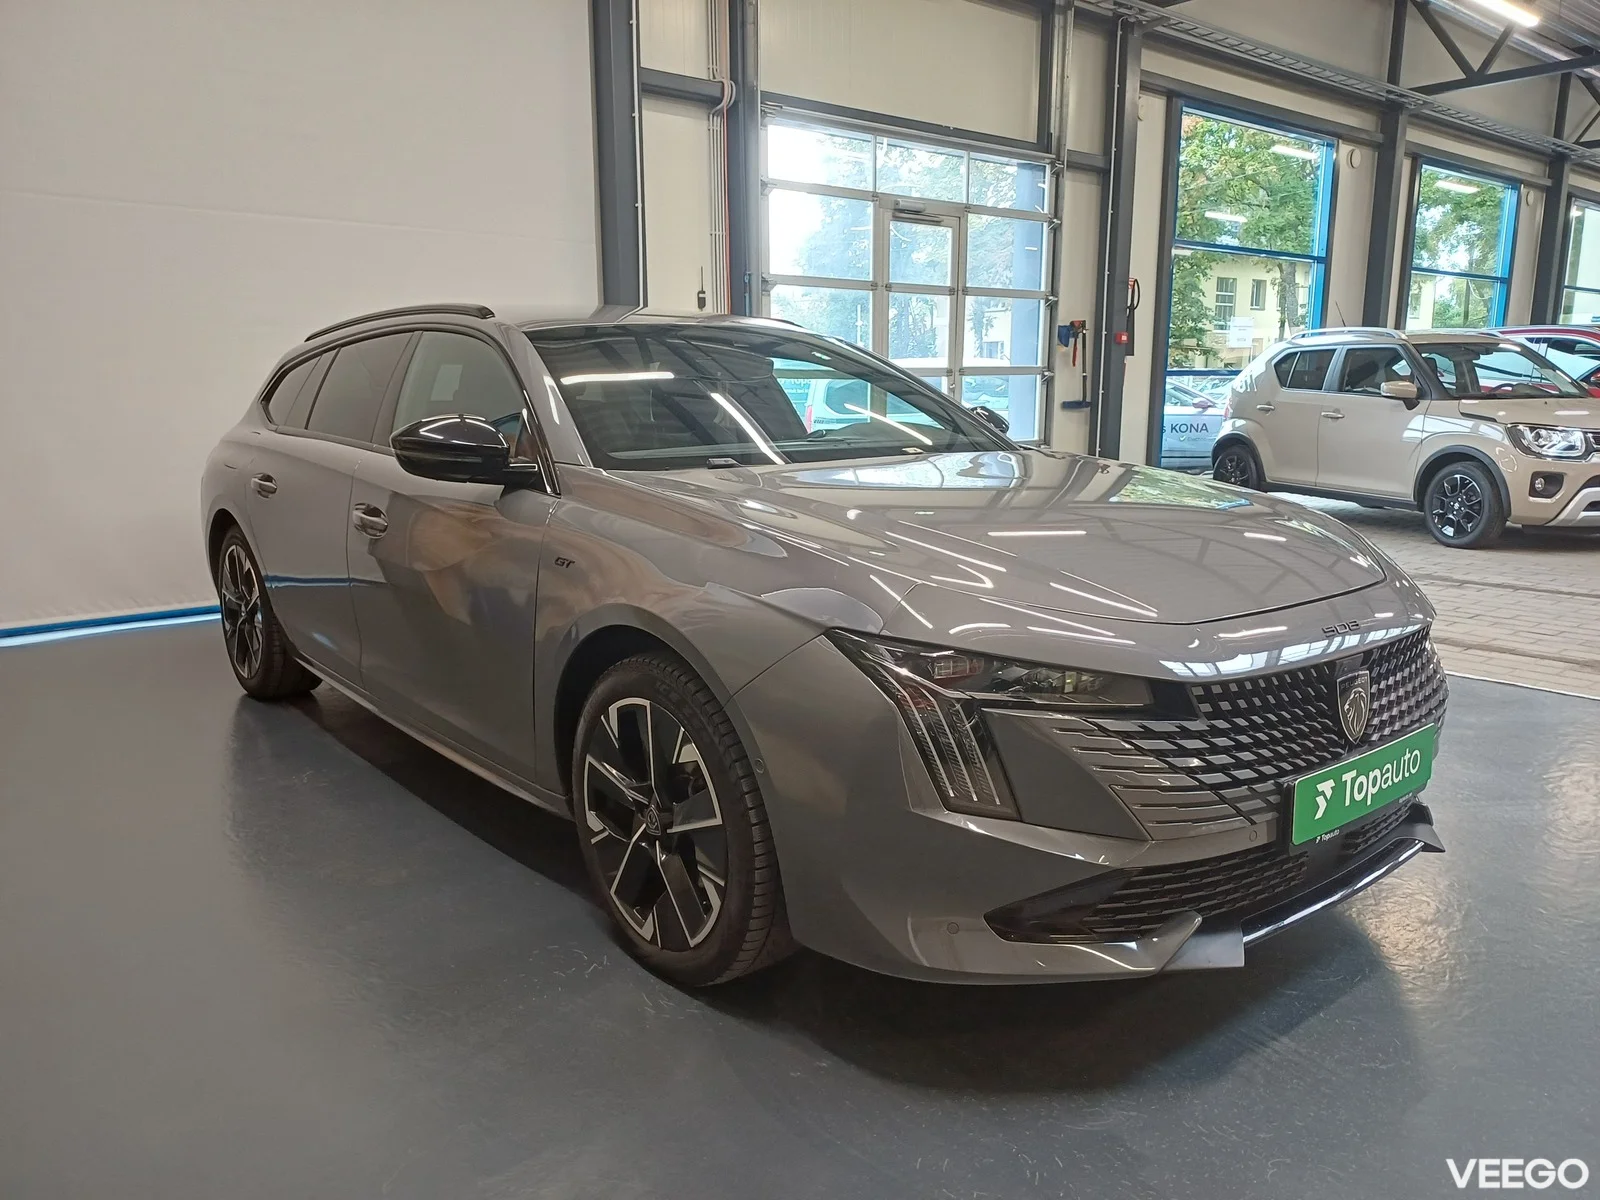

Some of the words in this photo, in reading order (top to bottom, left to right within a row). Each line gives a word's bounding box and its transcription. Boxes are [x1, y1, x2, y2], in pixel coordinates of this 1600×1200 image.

[1170, 422, 1209, 434] KONA
[554, 556, 576, 569] GT
[1341, 747, 1421, 807] Topauto
